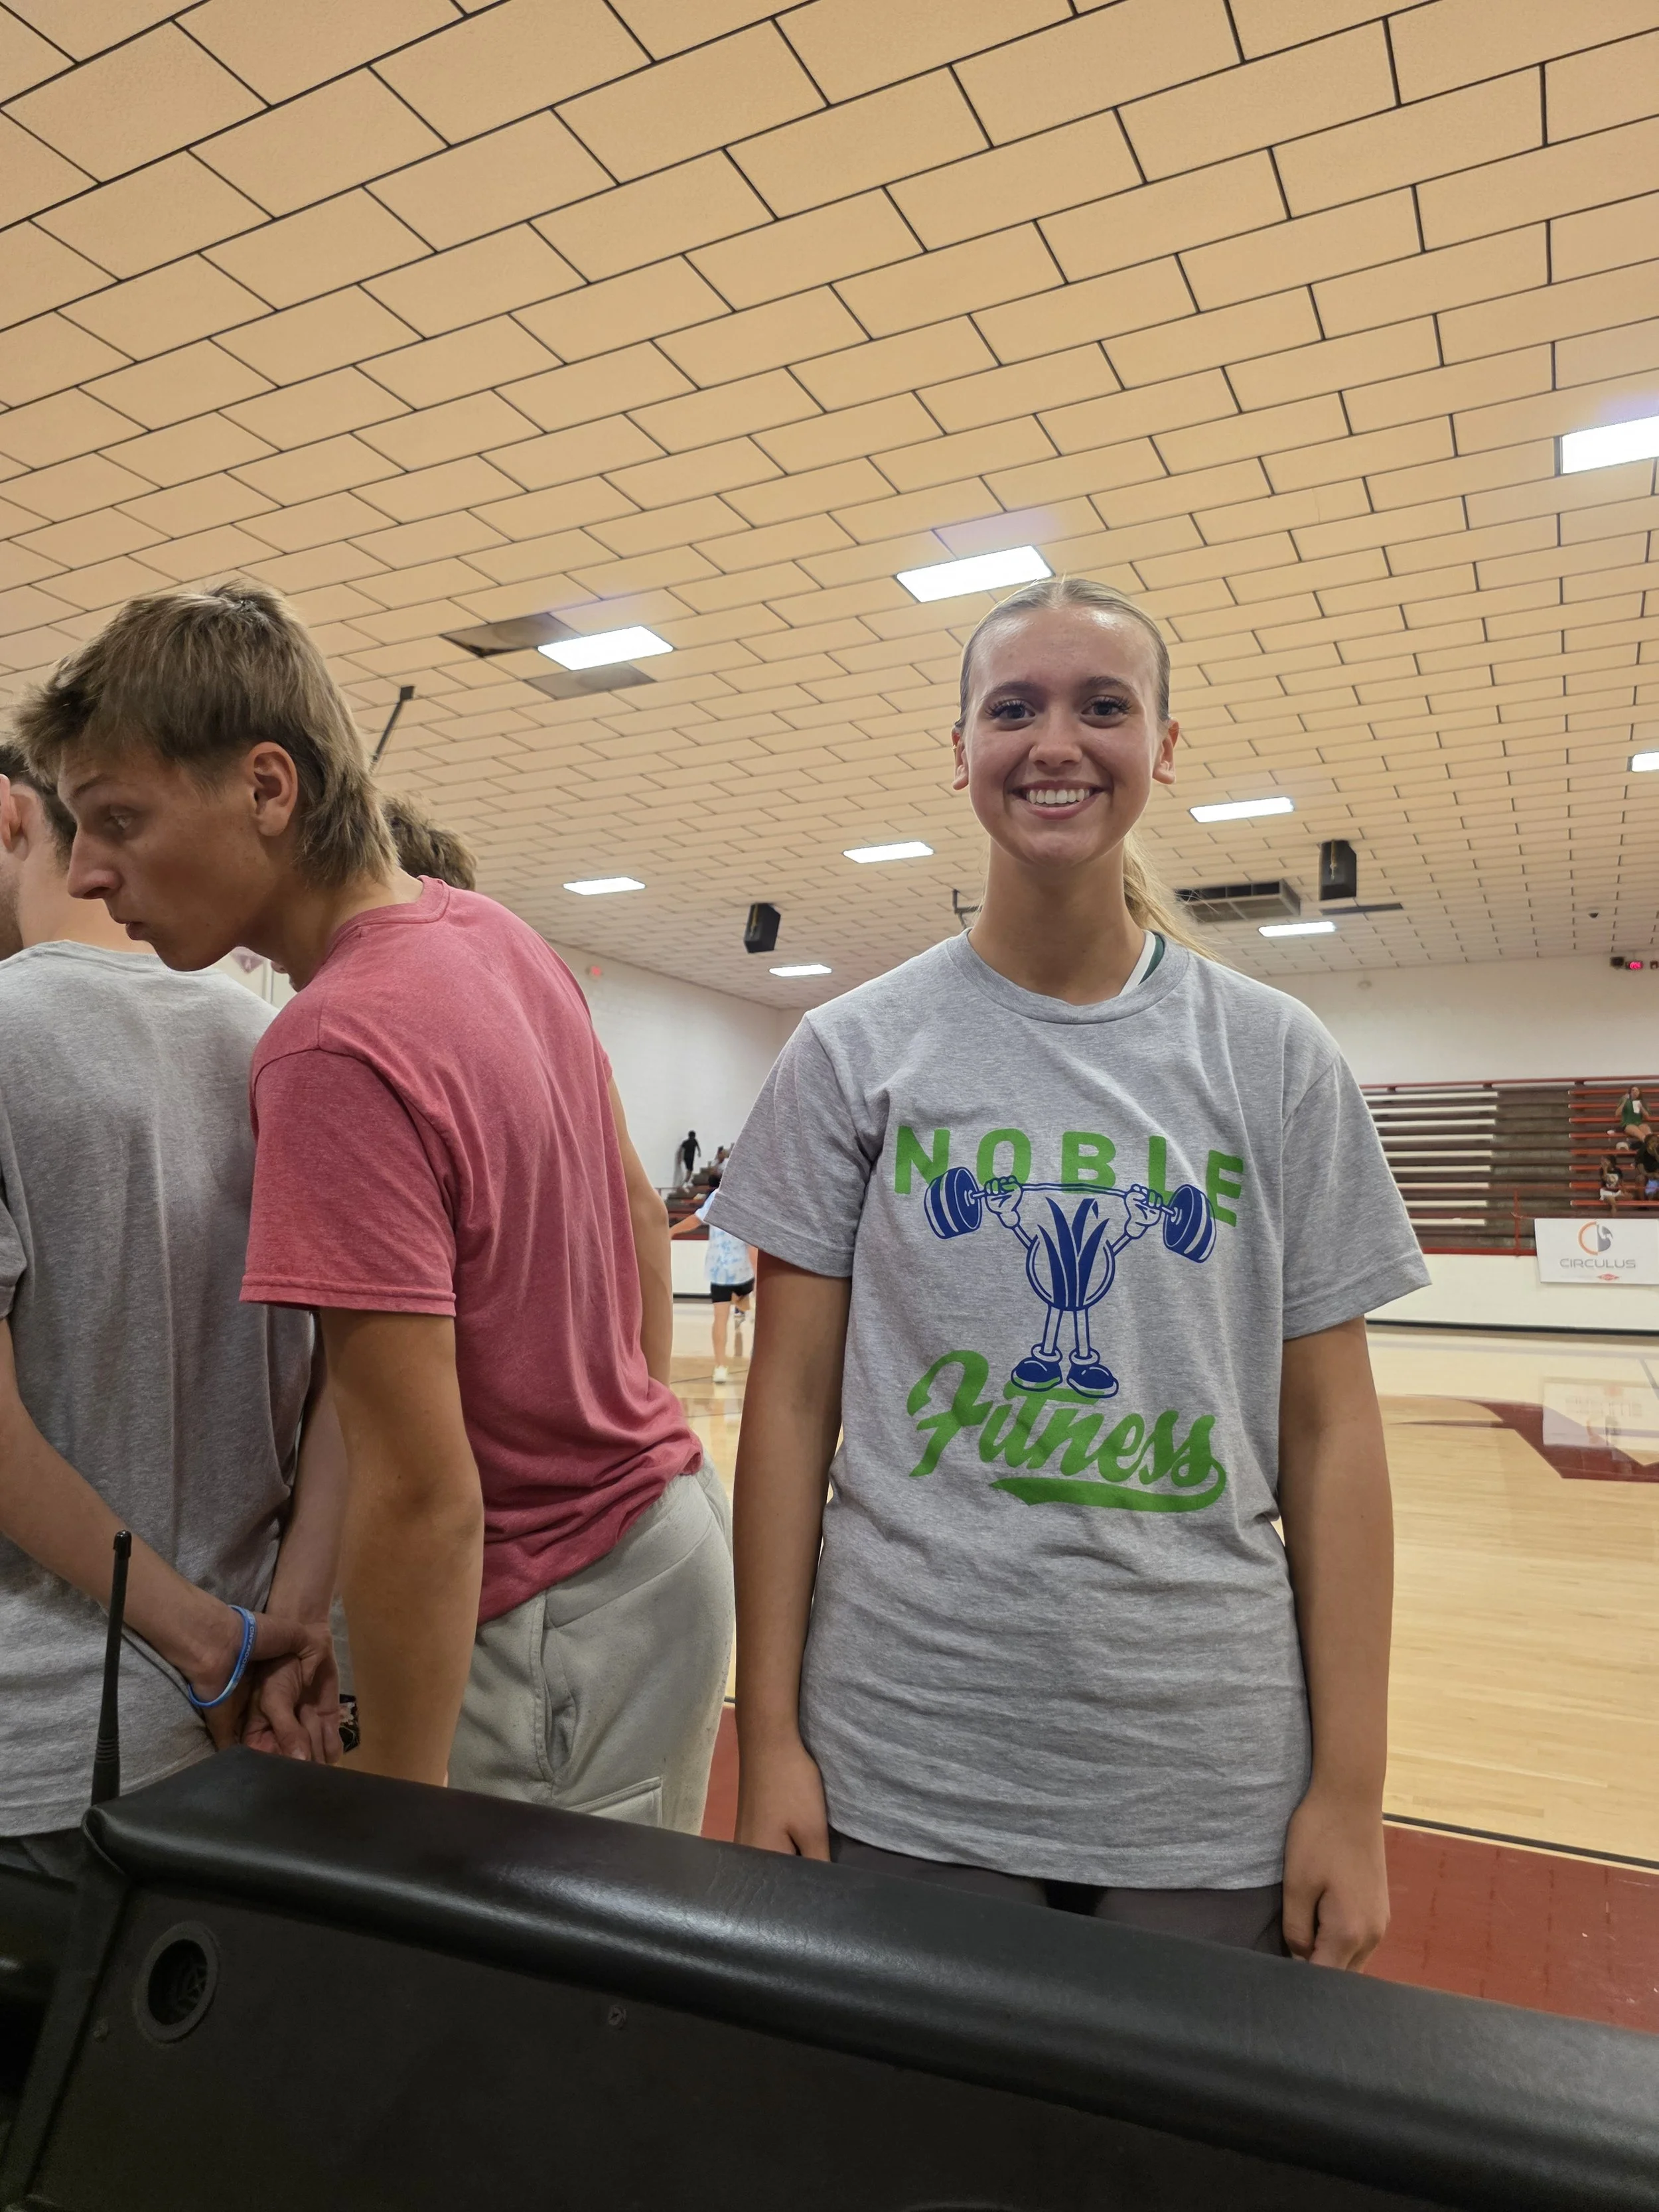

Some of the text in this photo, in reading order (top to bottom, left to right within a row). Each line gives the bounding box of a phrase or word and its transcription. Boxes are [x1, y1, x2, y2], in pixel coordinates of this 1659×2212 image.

[894, 1126, 1245, 1227] NOBLE
[1559, 1258, 1636, 1269] CIRCULUS
[906, 1350, 1226, 1488] Fitness
